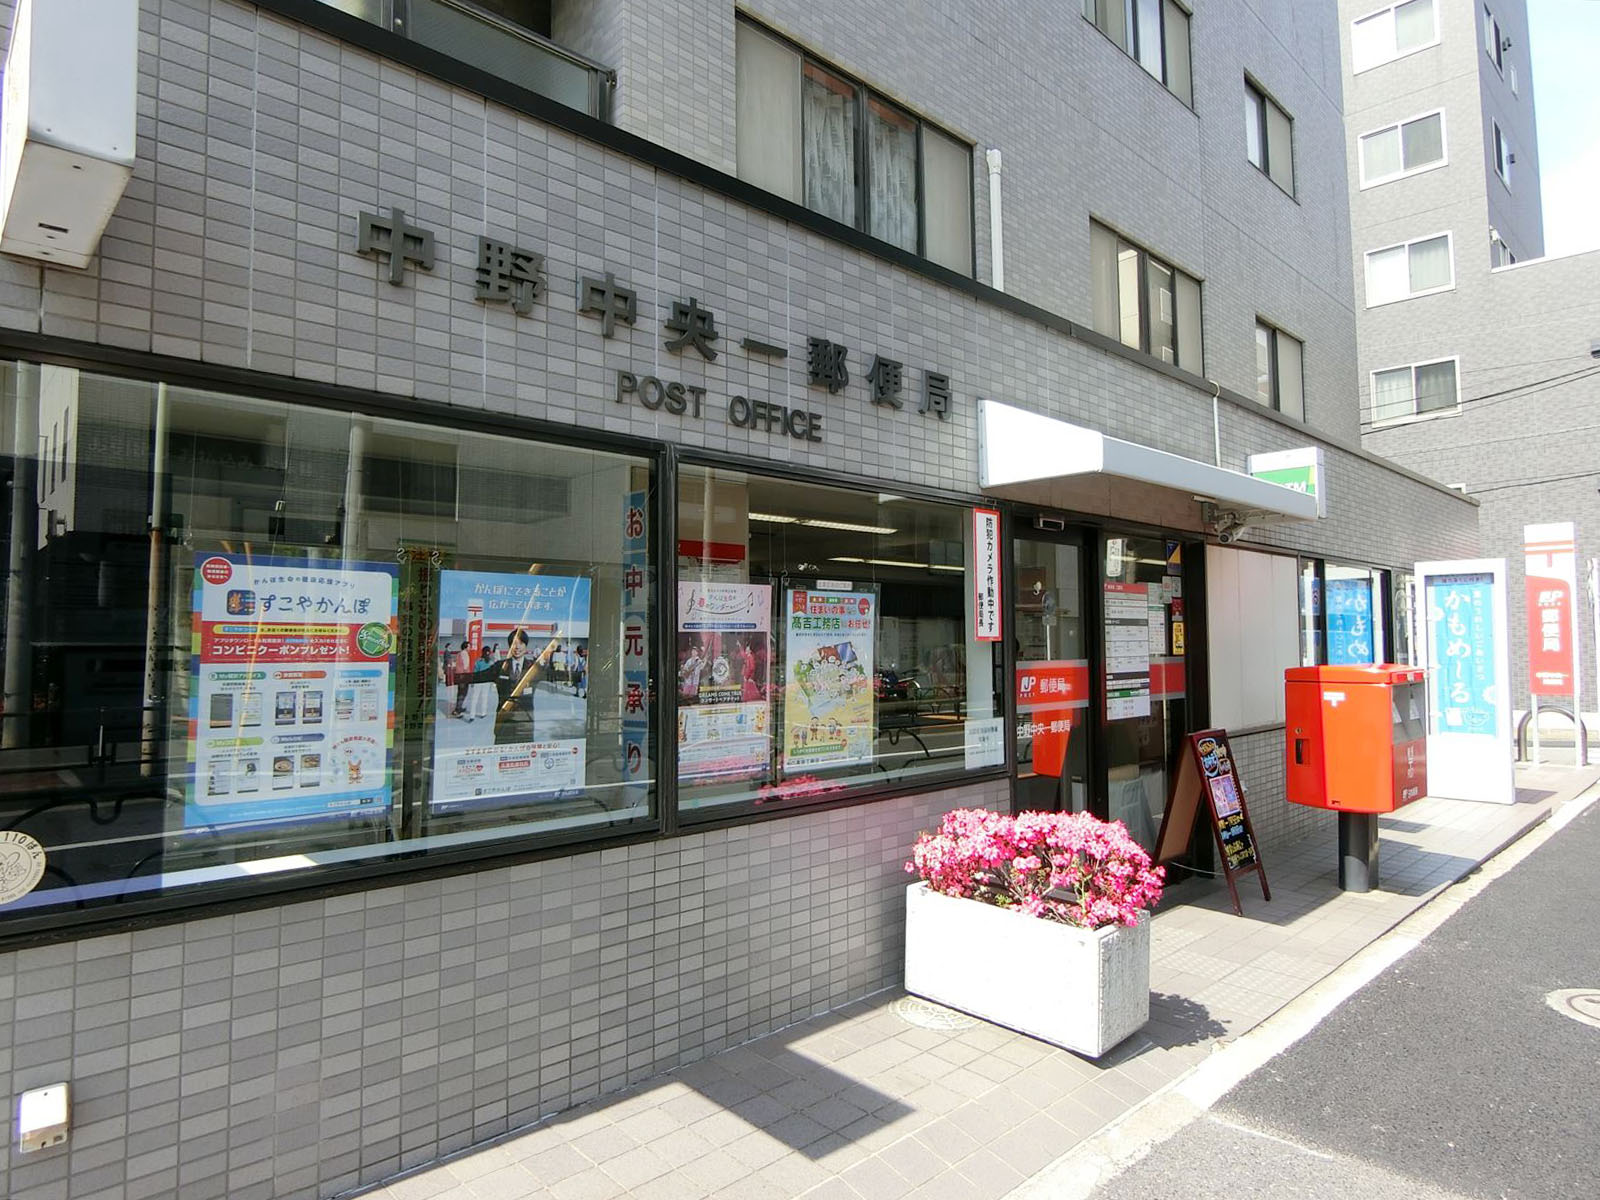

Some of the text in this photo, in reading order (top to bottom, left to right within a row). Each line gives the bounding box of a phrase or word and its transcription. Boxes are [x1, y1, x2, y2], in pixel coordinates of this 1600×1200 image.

[356, 206, 953, 422] 中野中央一郵便局
[616, 370, 823, 442] POST OFFICE
[260, 594, 371, 615] すこやかんぽ
[1040, 677, 1066, 694] 郵便局
